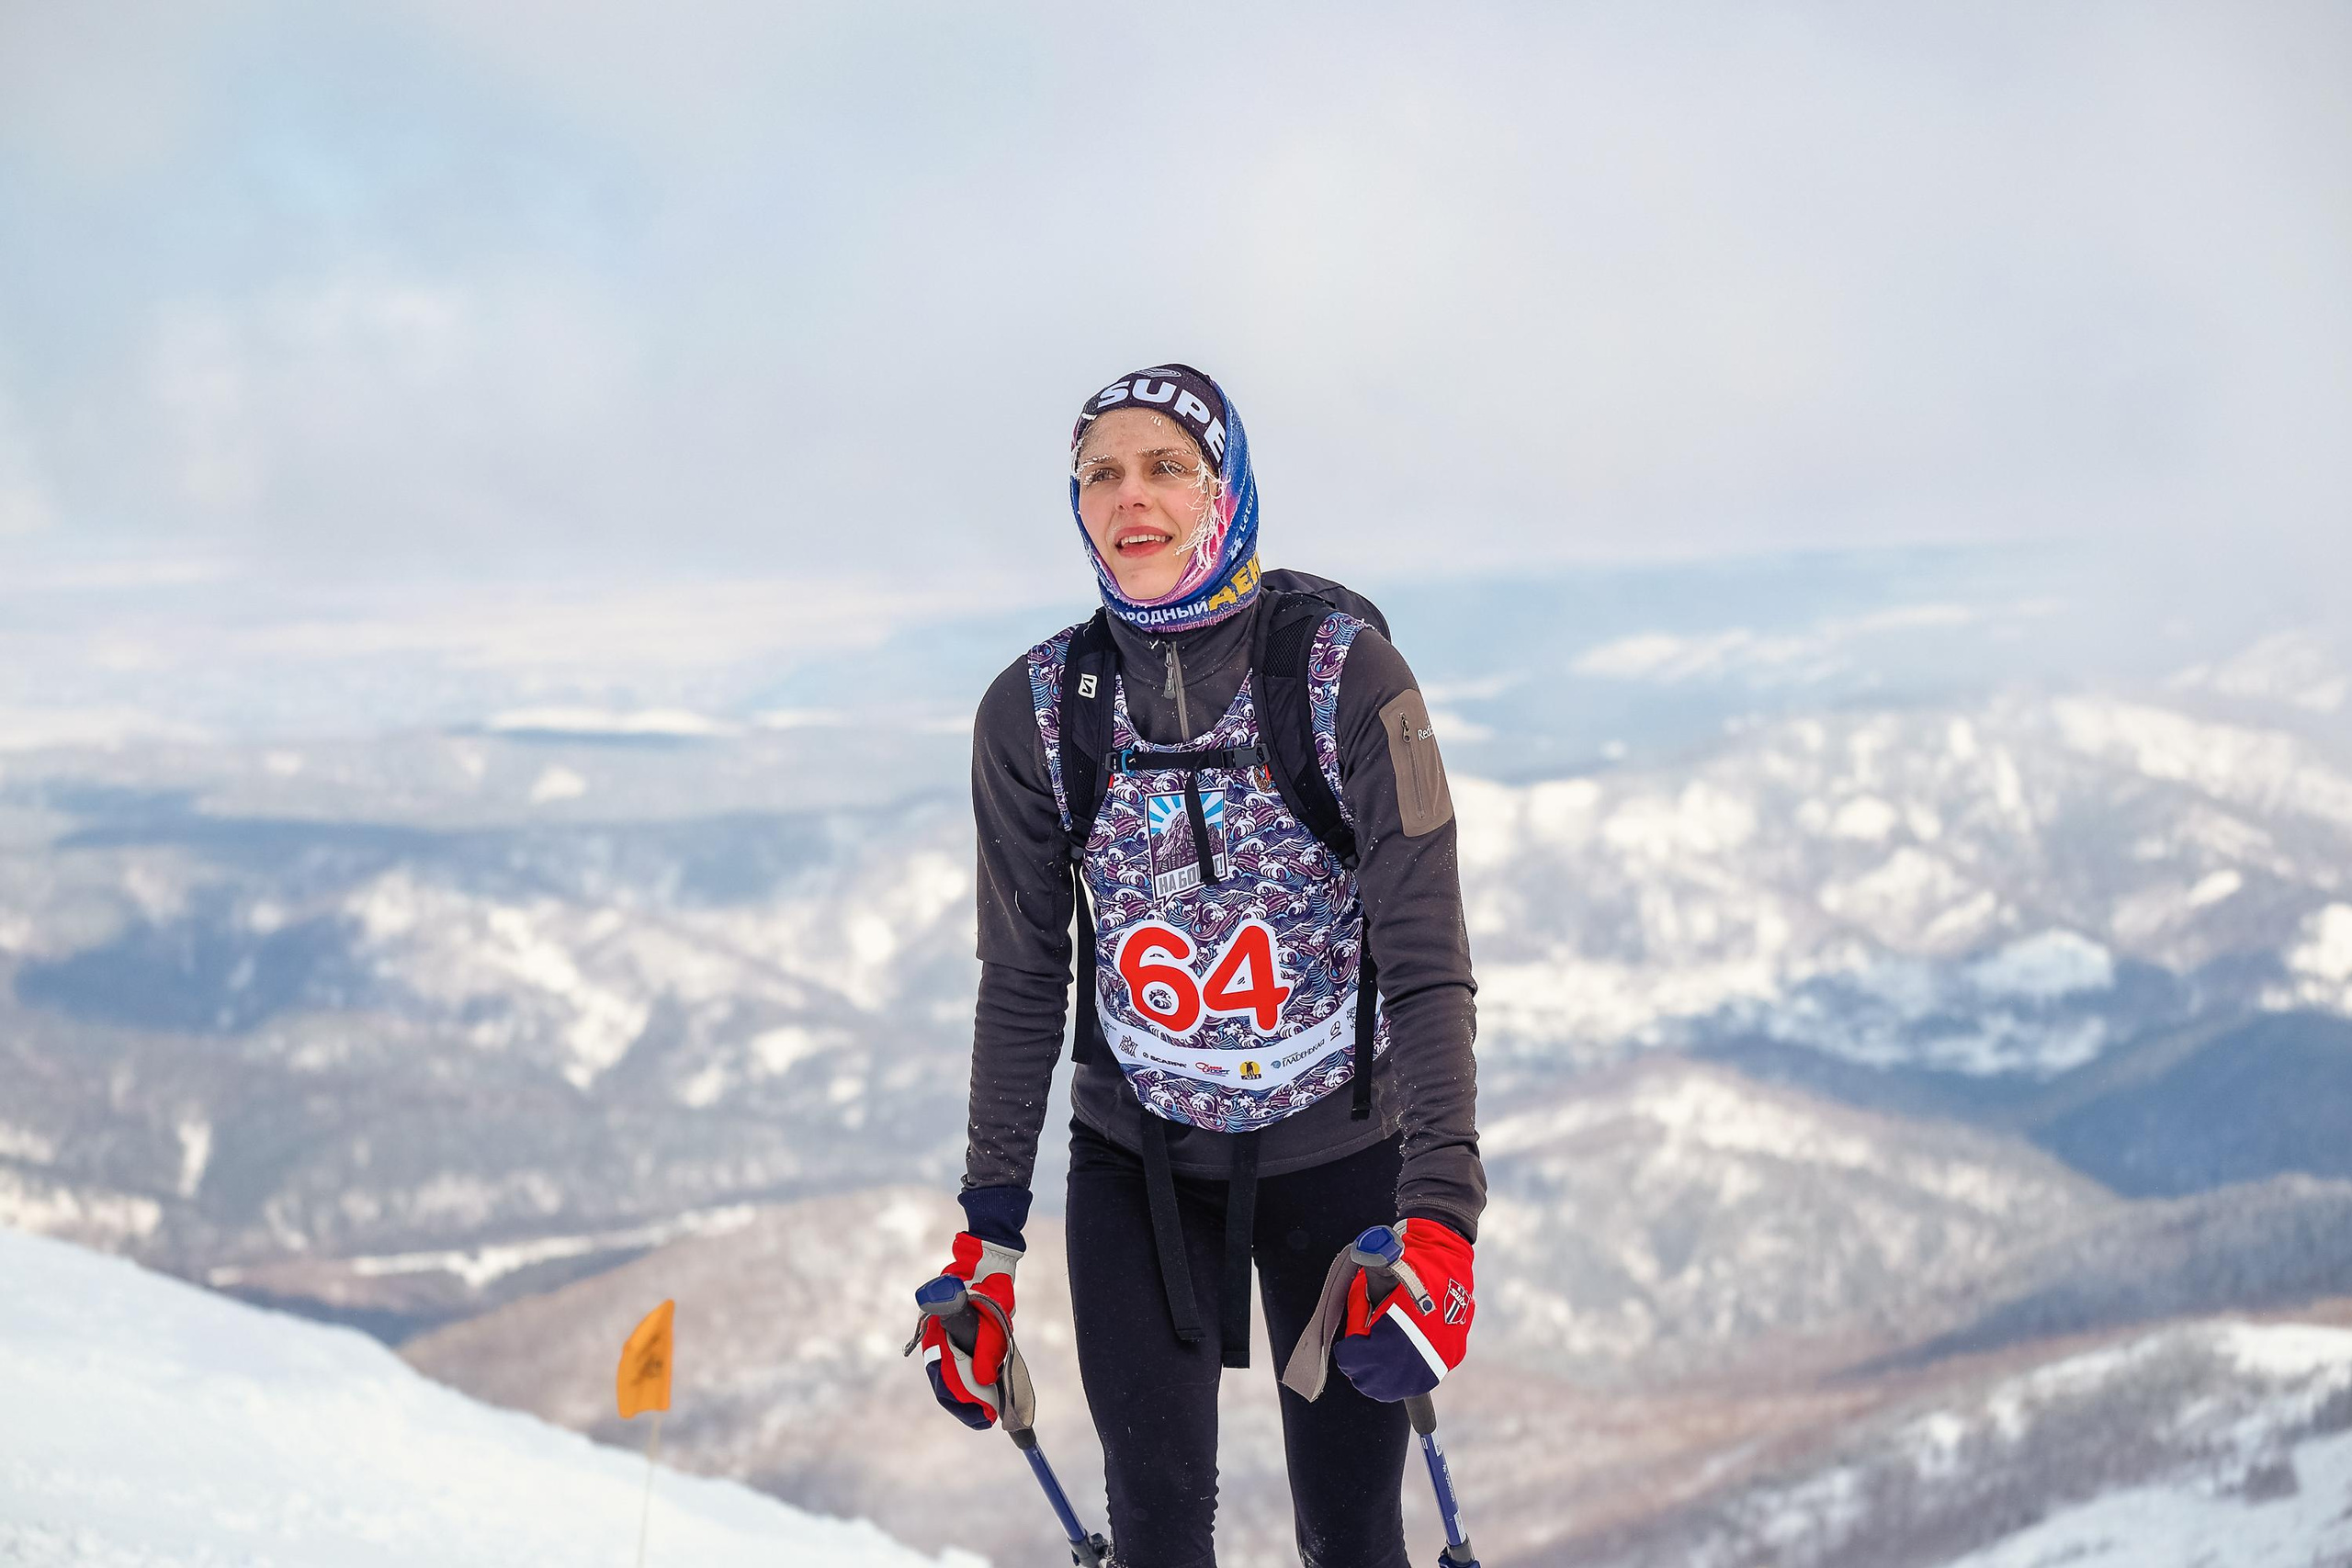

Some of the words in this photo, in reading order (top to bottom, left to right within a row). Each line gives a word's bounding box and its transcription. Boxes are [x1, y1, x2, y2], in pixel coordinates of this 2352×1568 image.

[1208, 552, 1261, 612] ДЕН
[1158, 873, 1176, 896] НА
[1178, 855, 1224, 890] БОС!
[1119, 925, 1289, 1032] 64
[1149, 1055, 1186, 1068] SCARPA
